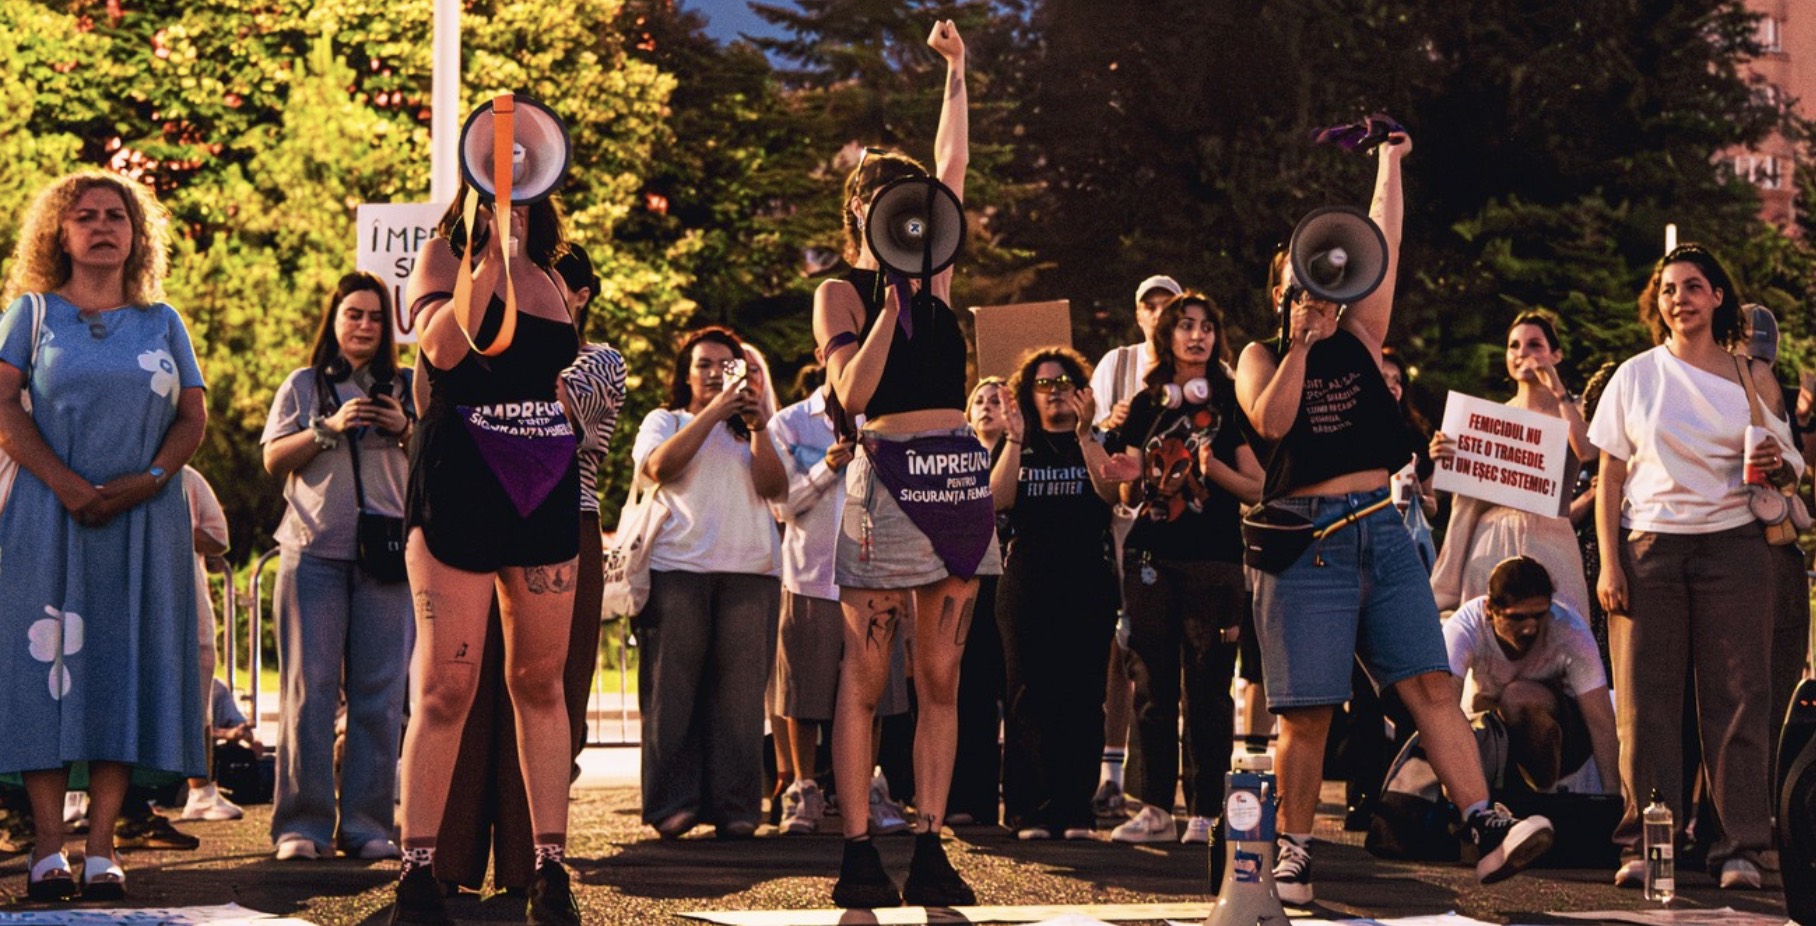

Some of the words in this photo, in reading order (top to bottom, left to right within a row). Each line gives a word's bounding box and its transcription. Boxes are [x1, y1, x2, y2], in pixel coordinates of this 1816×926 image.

[1468, 413, 1524, 442] FEMICIDUL
[1526, 427, 1542, 446] NU
[1457, 434, 1482, 456] ESTE
[1484, 441, 1493, 457] O
[1495, 442, 1545, 472] TRAGEDIE,
[946, 476, 977, 489] PENTRU
[1028, 482, 1044, 496] FLY
[1441, 456, 1454, 471] CI
[1456, 457, 1472, 475] UN
[1472, 461, 1499, 483] EȘEC
[1500, 467, 1550, 496] SISTEMIC
